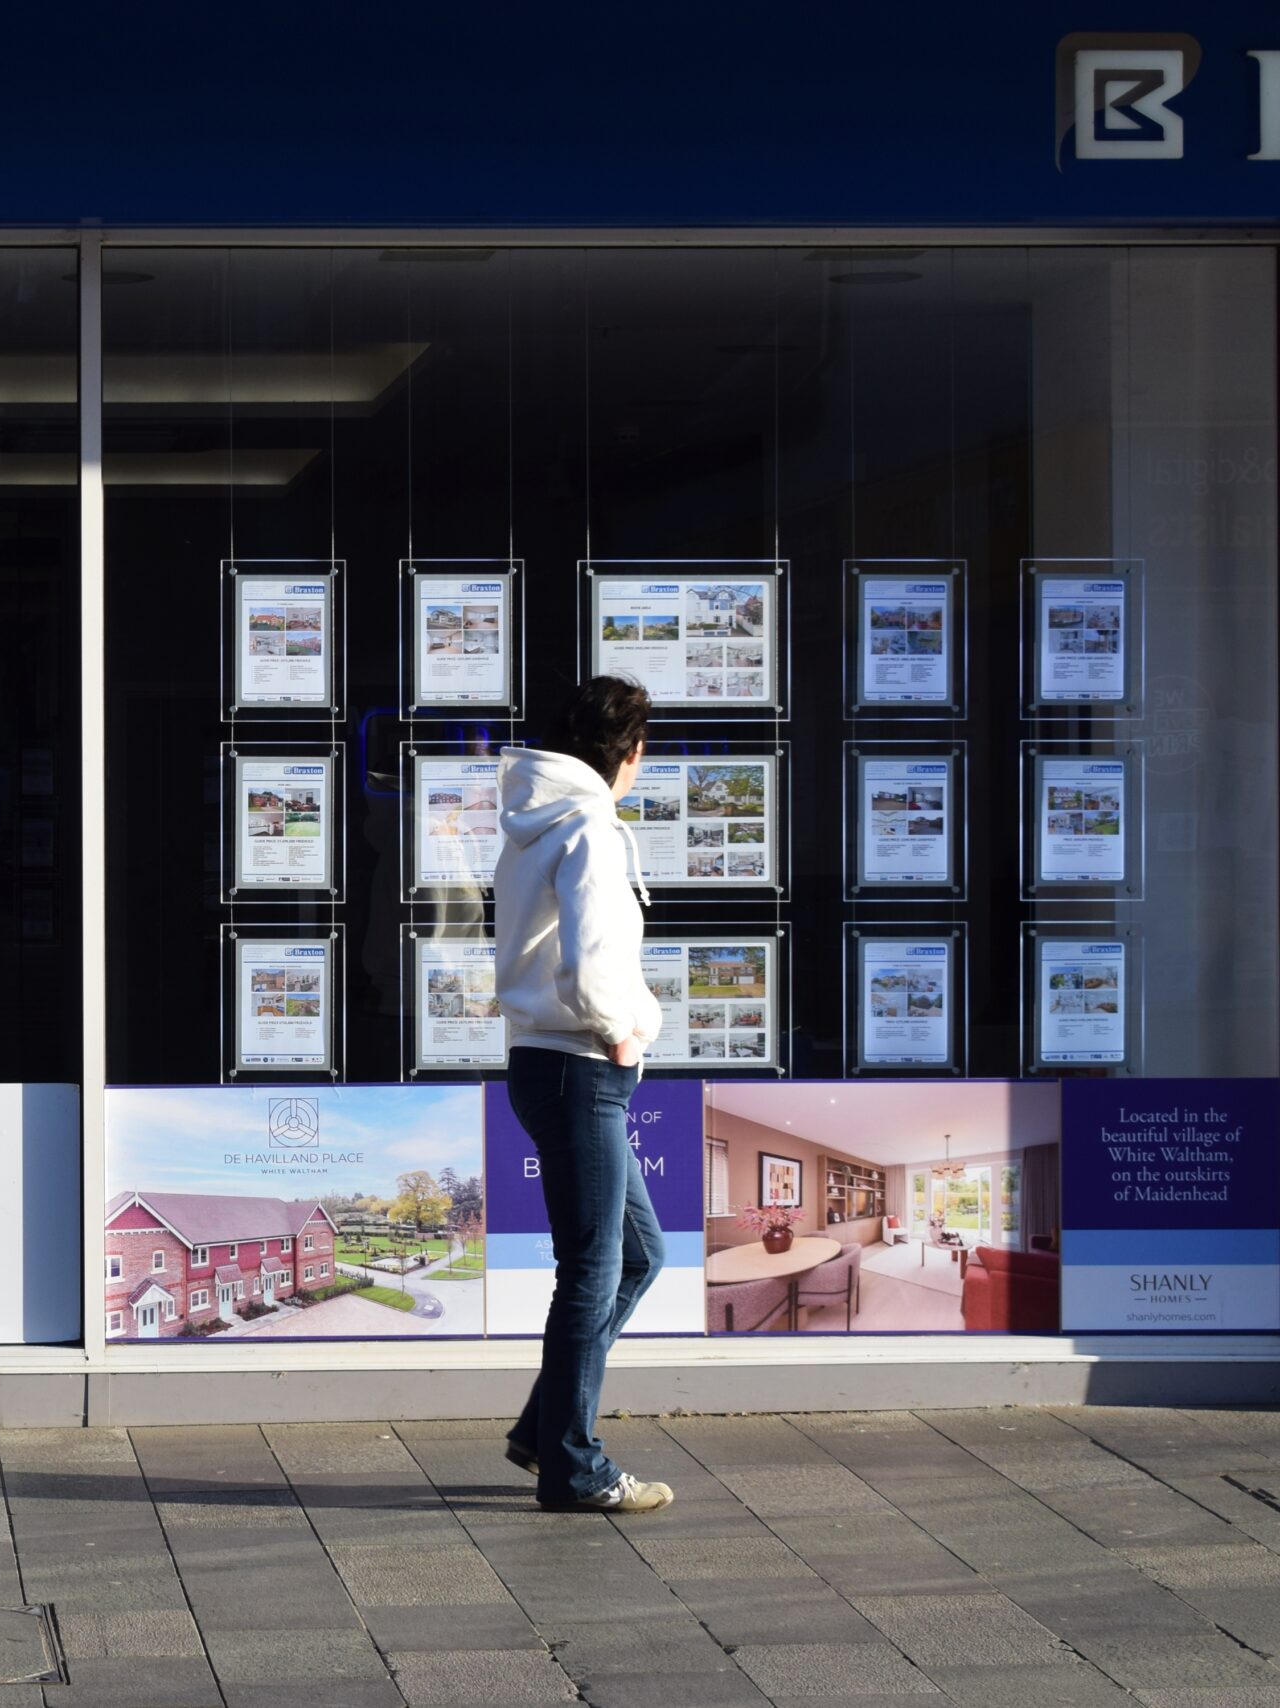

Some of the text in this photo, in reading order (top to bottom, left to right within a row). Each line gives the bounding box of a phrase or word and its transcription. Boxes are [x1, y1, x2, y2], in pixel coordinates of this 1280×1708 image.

[641, 1111, 662, 1124] OF
[1119, 1106, 1228, 1124] Located in the
[628, 1130, 641, 1150] 4
[1101, 1126, 1243, 1146] beautiful village of
[223, 1152, 364, 1165] DE HAVILLAND PLACE
[1107, 1146, 1234, 1164] White Waltham,
[1111, 1165, 1231, 1182] on the outskirts
[1113, 1185, 1228, 1202] of Maidenhead
[1130, 1273, 1213, 1292] SHANLY
[1150, 1294, 1192, 1304] HOMES
[1126, 1311, 1216, 1323] shanlyhomes.com
